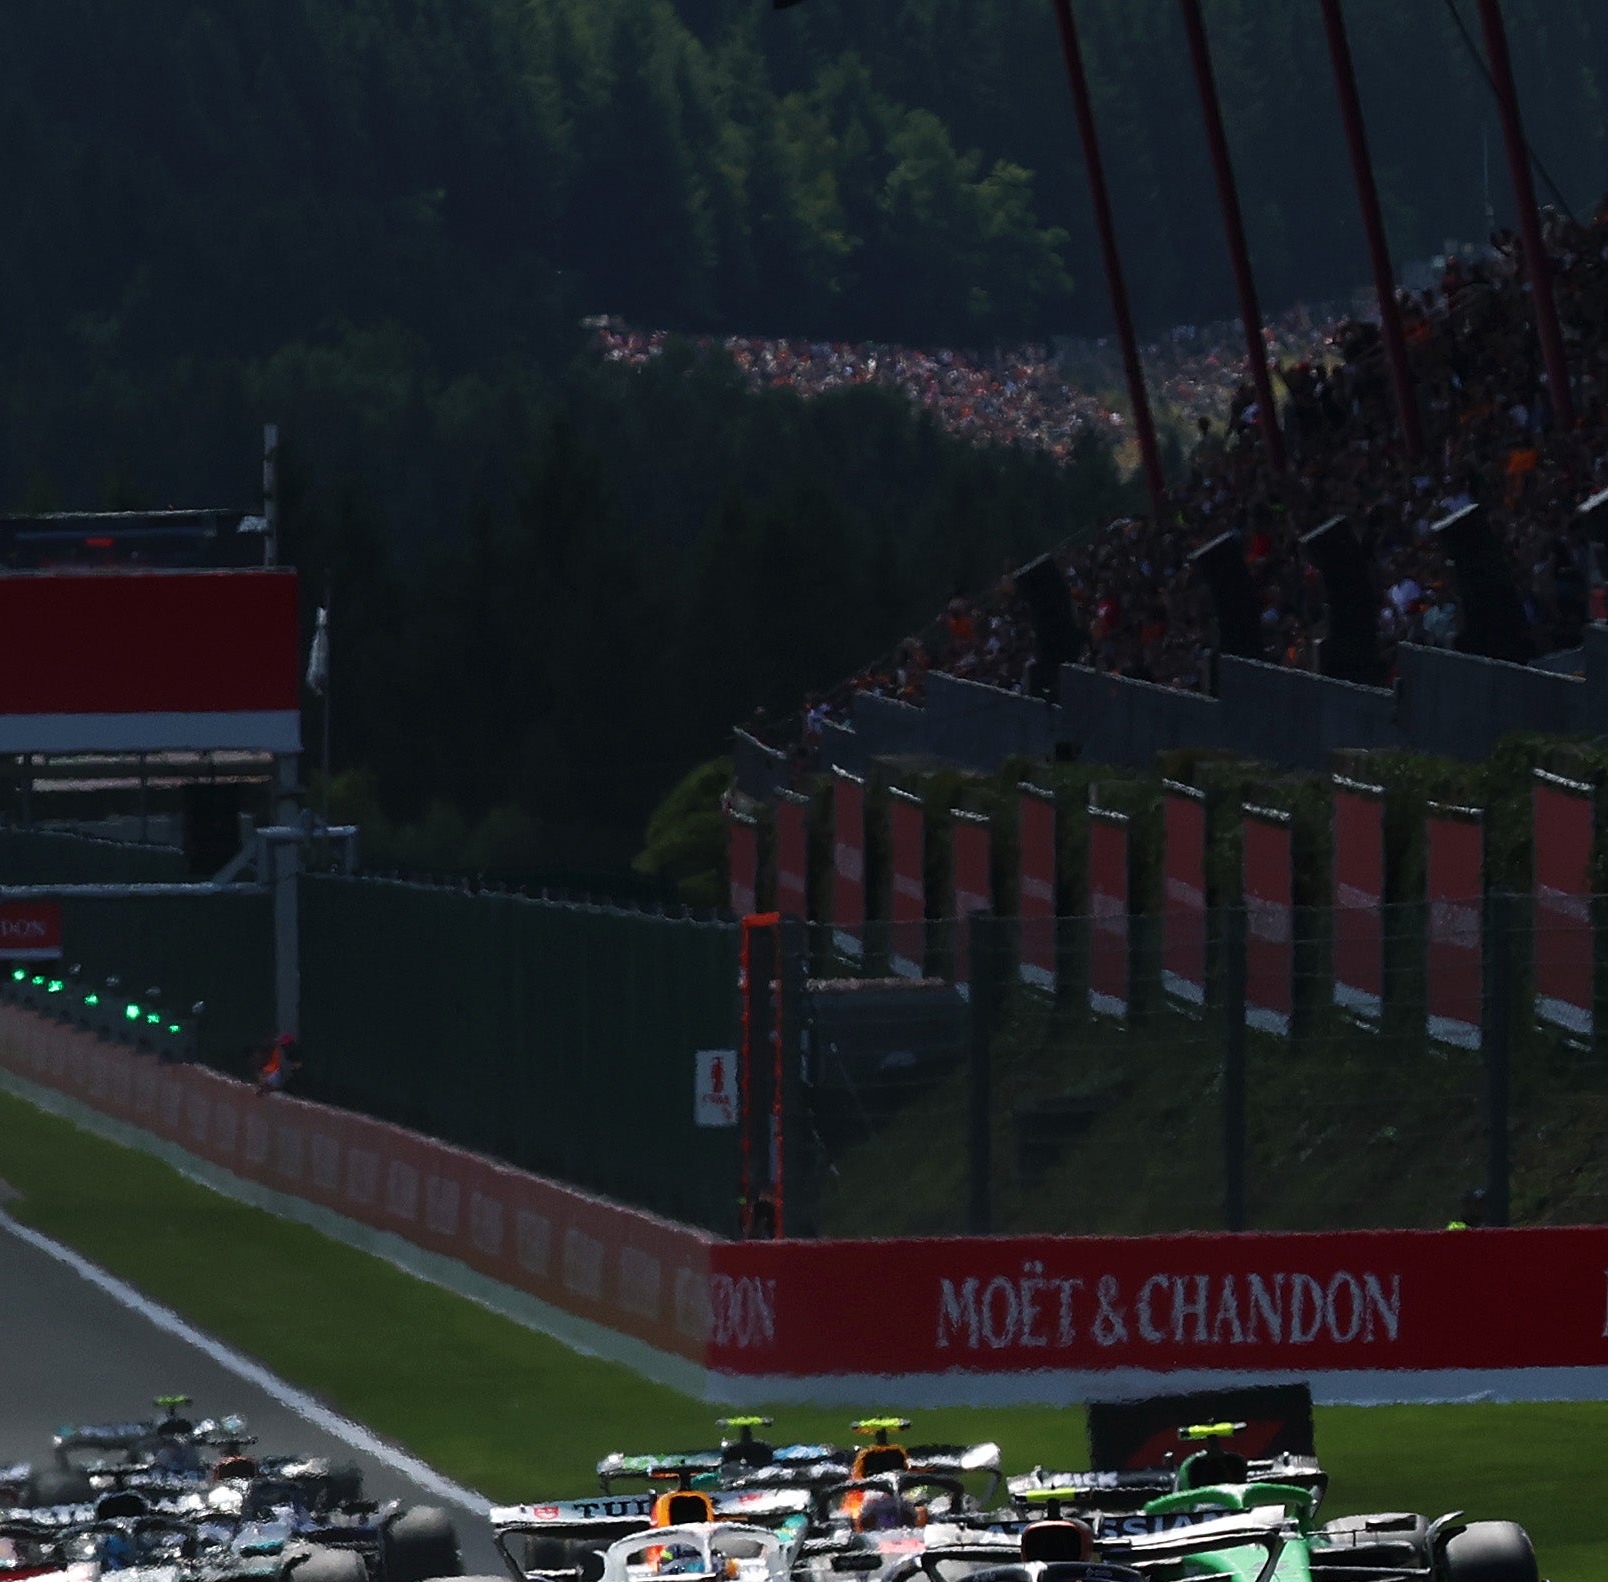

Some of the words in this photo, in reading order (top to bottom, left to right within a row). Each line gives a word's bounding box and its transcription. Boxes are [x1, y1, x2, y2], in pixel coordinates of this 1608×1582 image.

[936, 1262, 1082, 1351] MOËT
[1090, 1274, 1128, 1347] &
[1134, 1270, 1401, 1345] CHANDON
